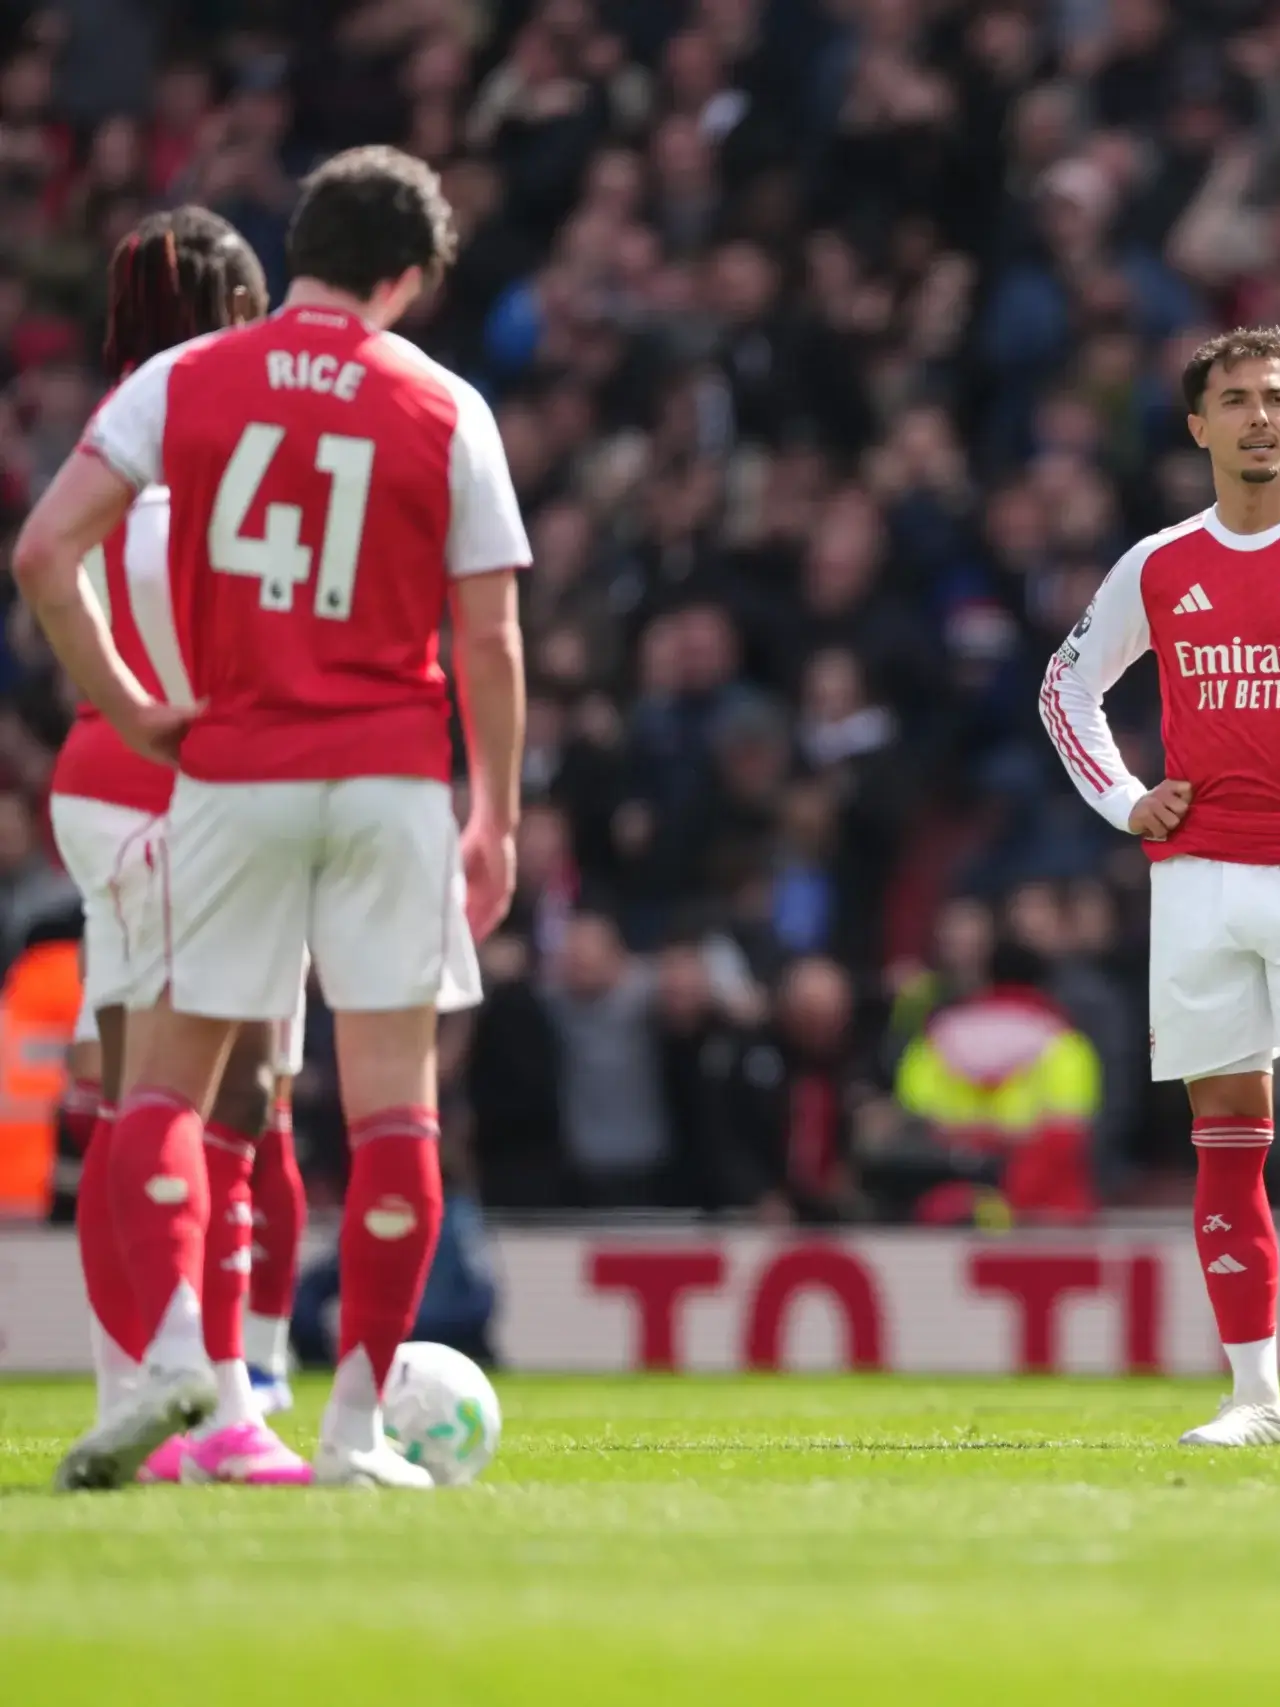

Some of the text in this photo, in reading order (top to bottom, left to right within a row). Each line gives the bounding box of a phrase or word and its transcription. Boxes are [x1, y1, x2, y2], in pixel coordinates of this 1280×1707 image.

[266, 349, 367, 403] RICE
[206, 421, 376, 622] 41
[1197, 679, 1229, 710] FLY
